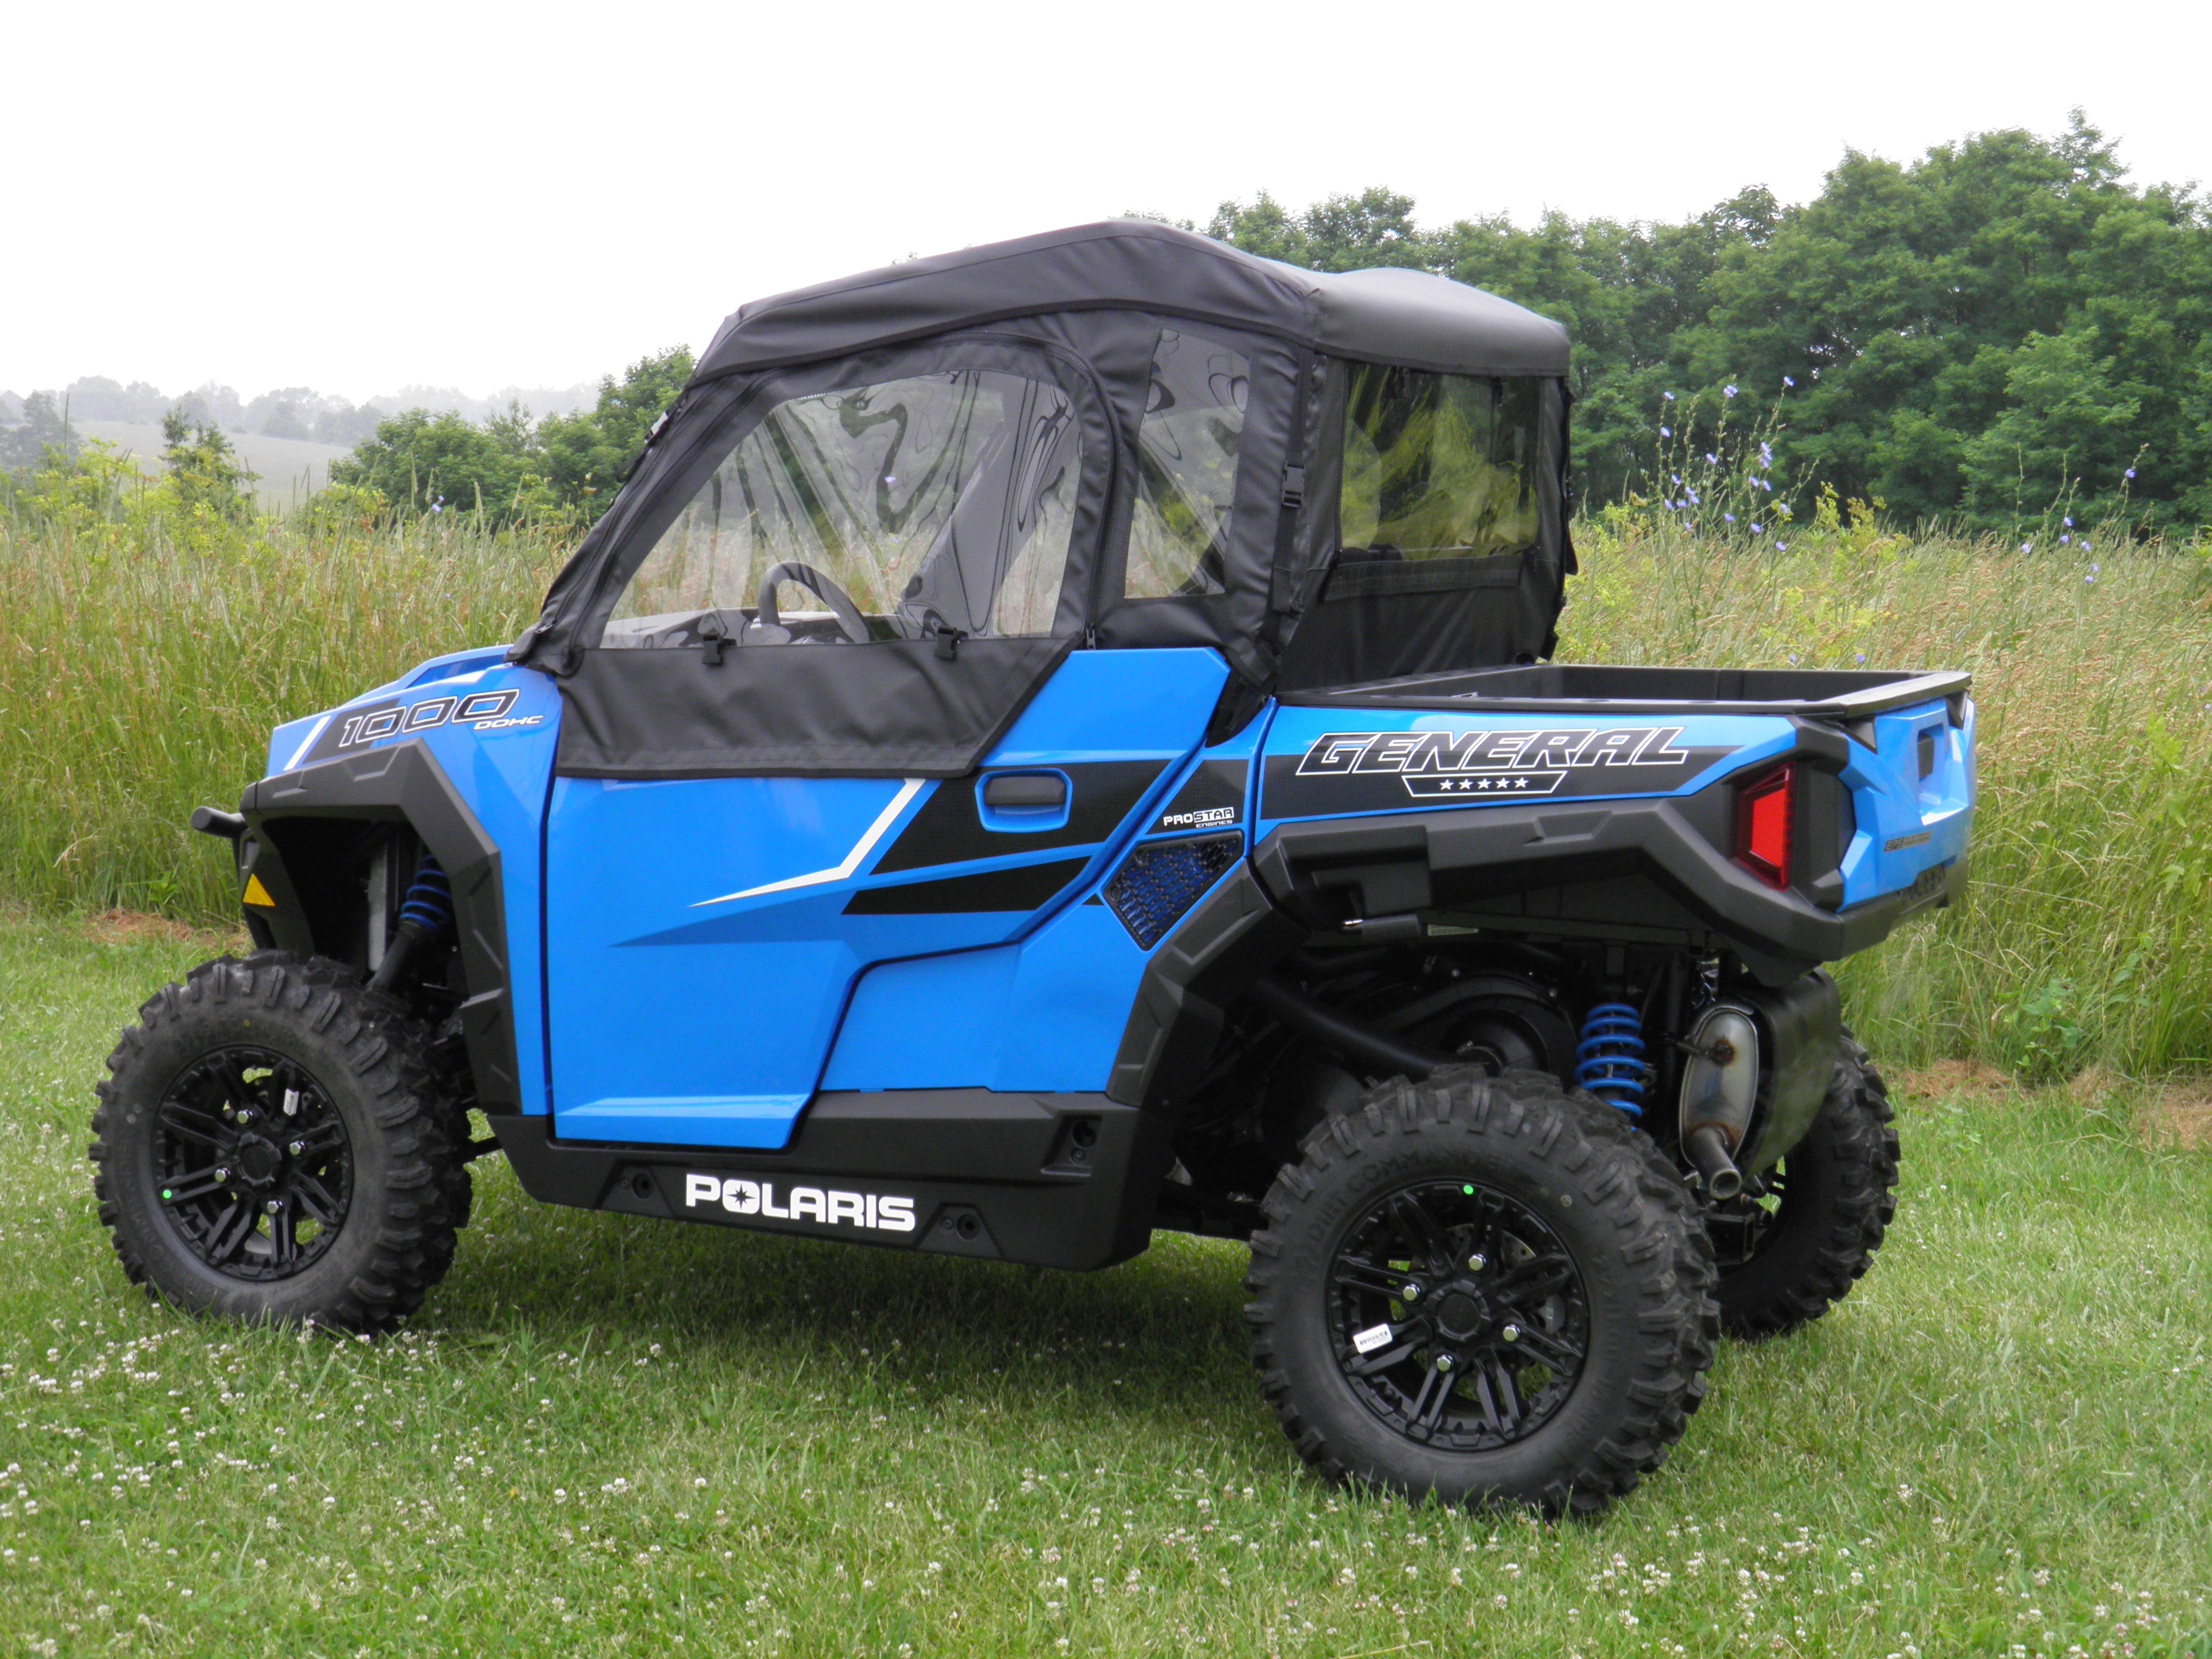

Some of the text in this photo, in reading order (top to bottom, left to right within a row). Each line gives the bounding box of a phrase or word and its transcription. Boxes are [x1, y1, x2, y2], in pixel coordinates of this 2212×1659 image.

[338, 688, 519, 747] 1000
[473, 715, 544, 731] DOHC
[1295, 726, 1689, 775] GENERAL
[1163, 806, 1234, 826] PROSTAR
[686, 1174, 915, 1231] POLARIS
